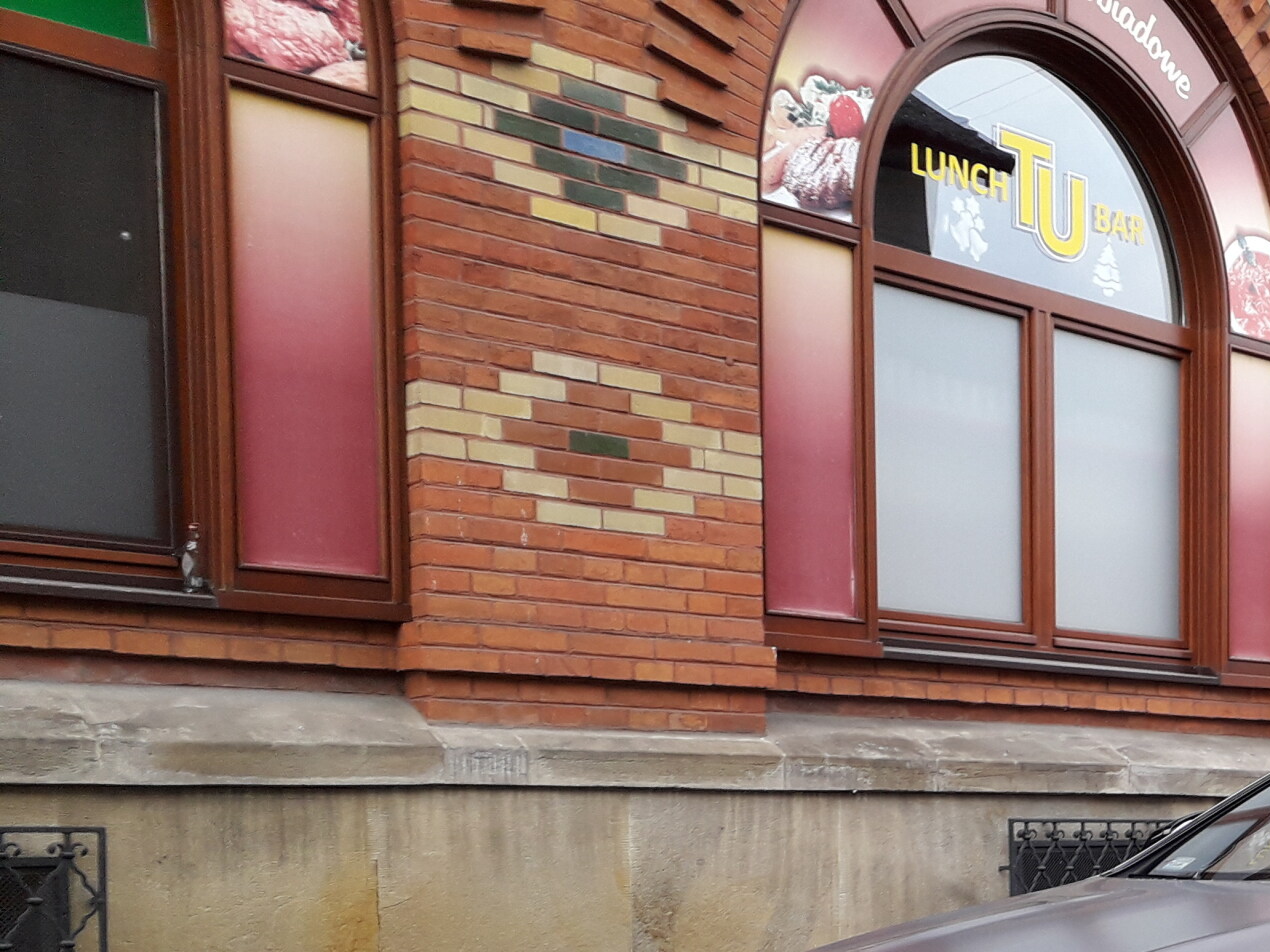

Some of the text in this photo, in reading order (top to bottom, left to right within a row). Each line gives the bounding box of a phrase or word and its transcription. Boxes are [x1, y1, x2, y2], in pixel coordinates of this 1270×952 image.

[1087, 0, 1191, 99] iadowe
[911, 126, 1146, 260] LUNCH TU BAR
